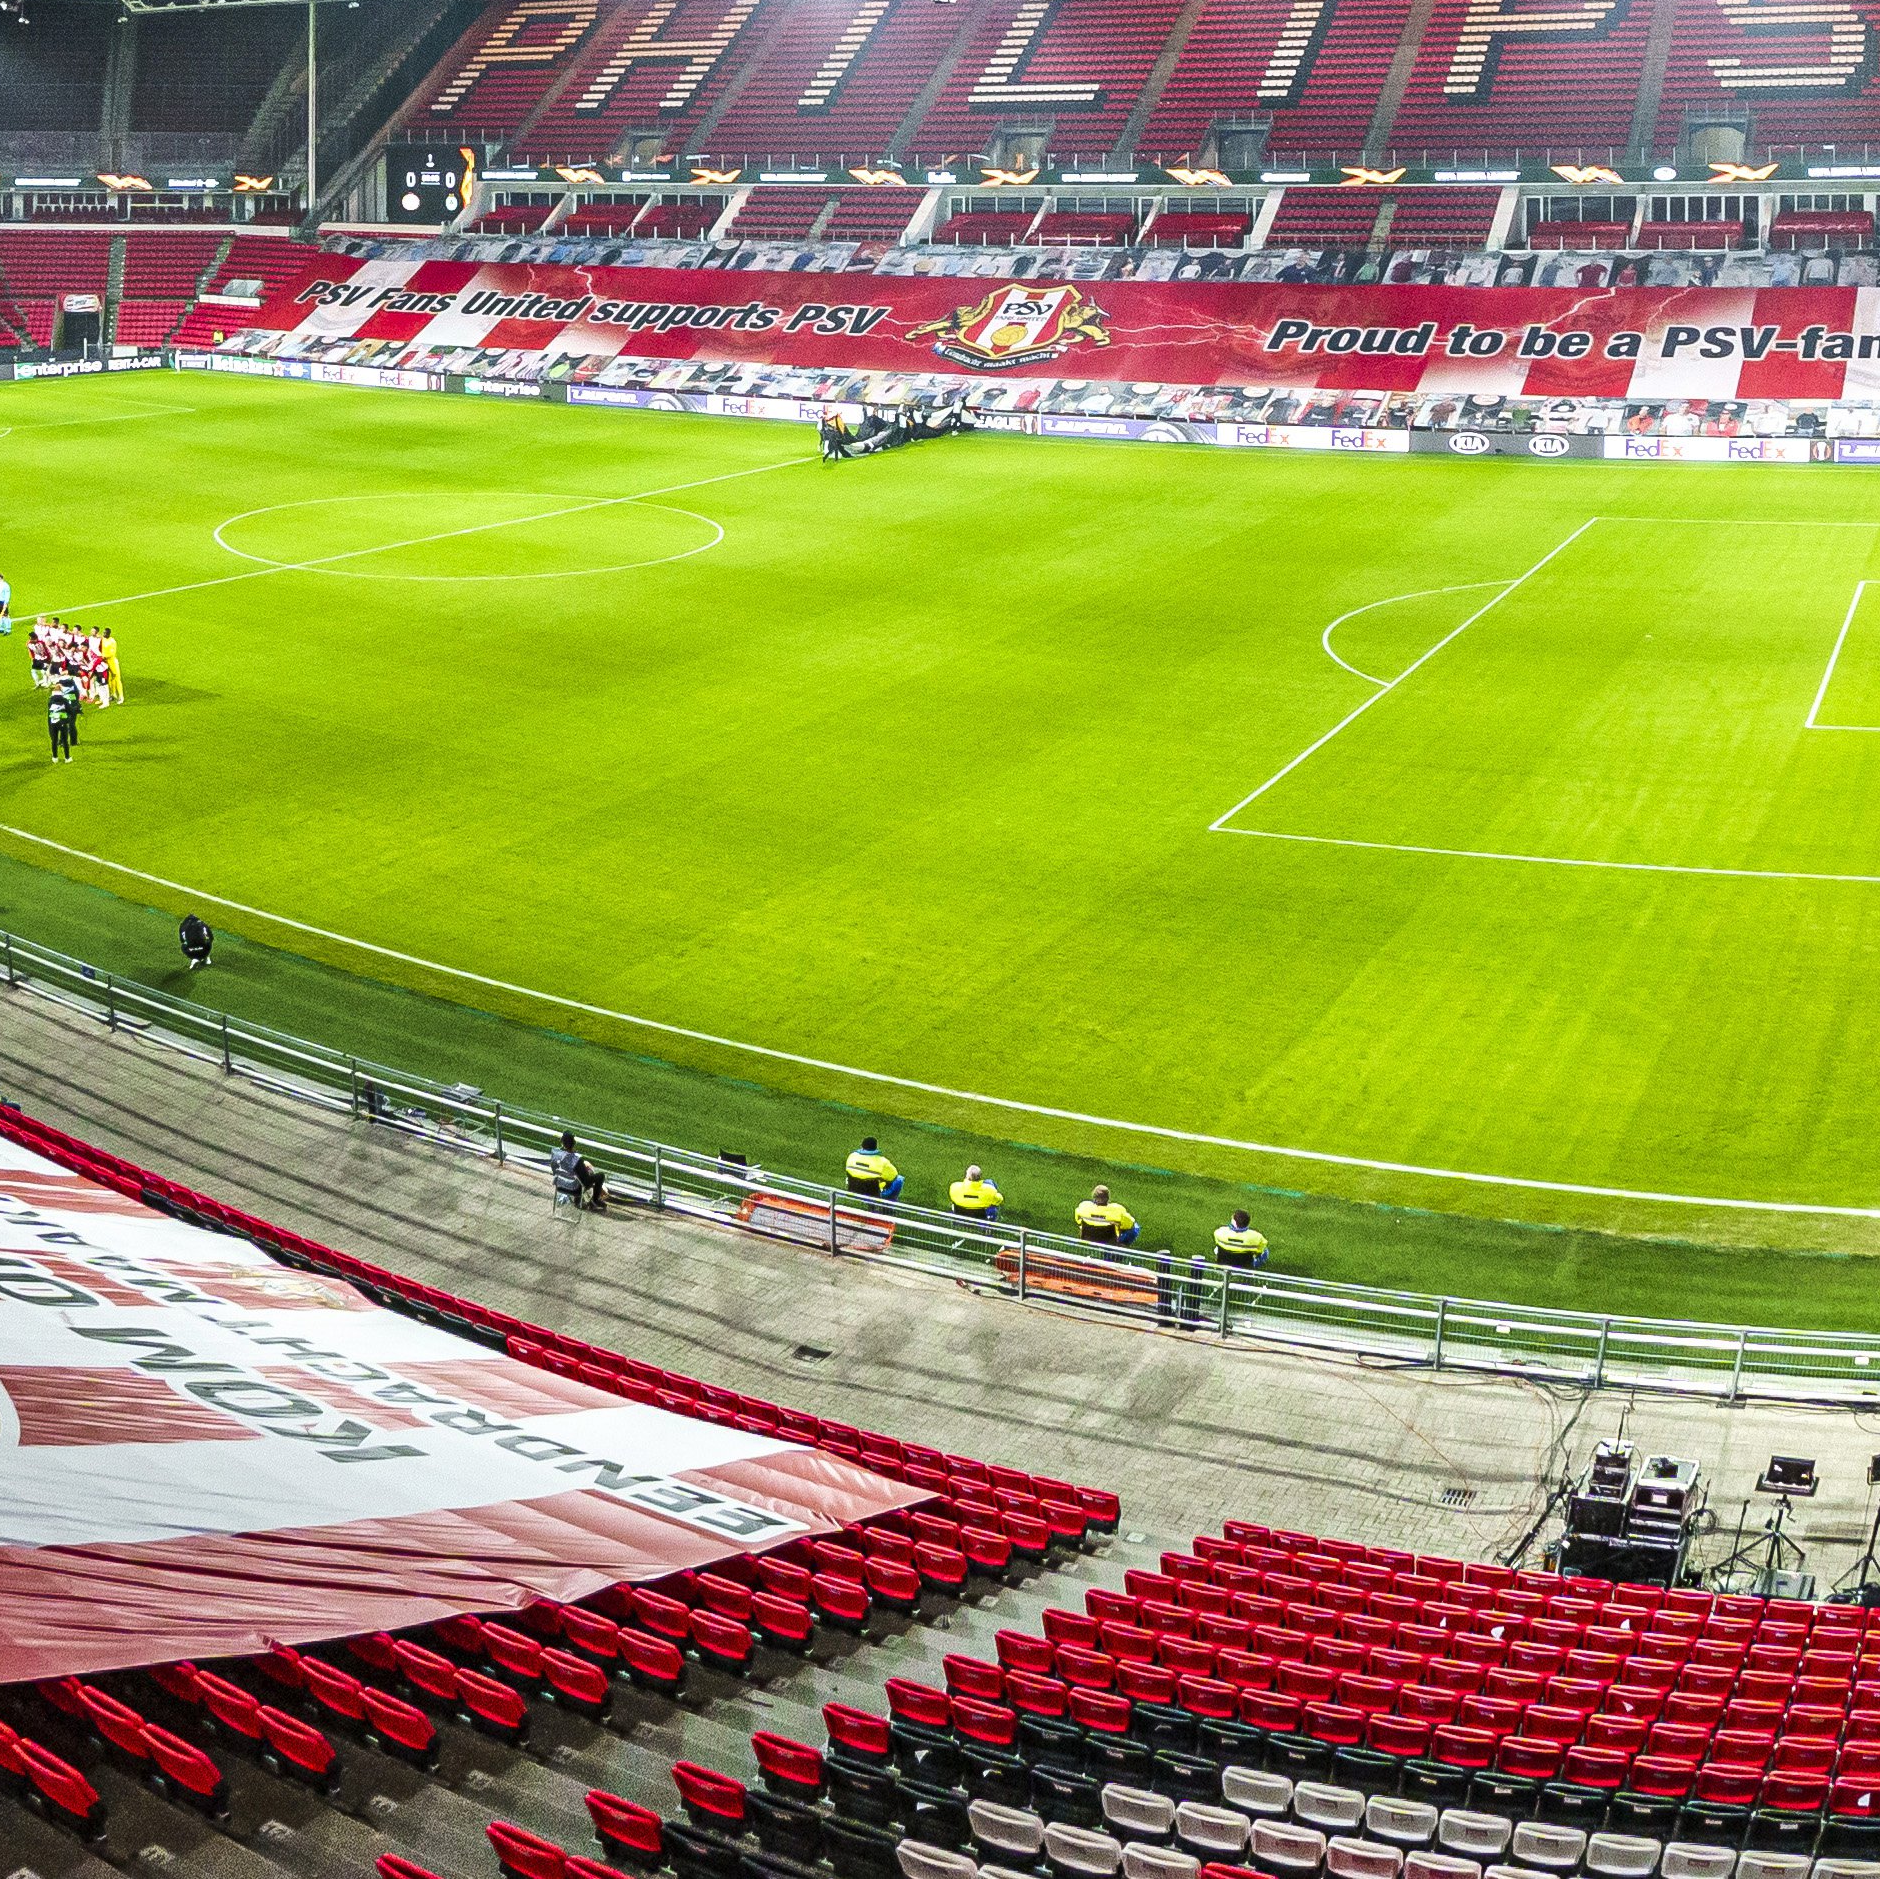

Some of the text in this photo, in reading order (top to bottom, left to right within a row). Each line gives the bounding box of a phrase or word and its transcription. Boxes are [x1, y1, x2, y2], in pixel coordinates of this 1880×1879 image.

[406, 172, 416, 188] 0
[446, 172, 455, 188] 0
[302, 280, 890, 336] PSV Fans United supports PSV
[1002, 301, 1053, 316] PSV
[1268, 321, 1435, 355] Proud
[1447, 324, 1505, 356] to
[1522, 326, 1589, 357] be
[1606, 333, 1640, 358] a
[108, 356, 161, 370] RENT-A-CAR
[722, 398, 766, 418] FedEx
[1236, 425, 1290, 445] FedEx
[1331, 429, 1387, 449] FedEx
[1625, 438, 1684, 458] FedEx
[1728, 440, 1786, 460] FedEx
[68, 1326, 430, 1463] KOM
[199, 1314, 789, 1536] EENDRACHT
